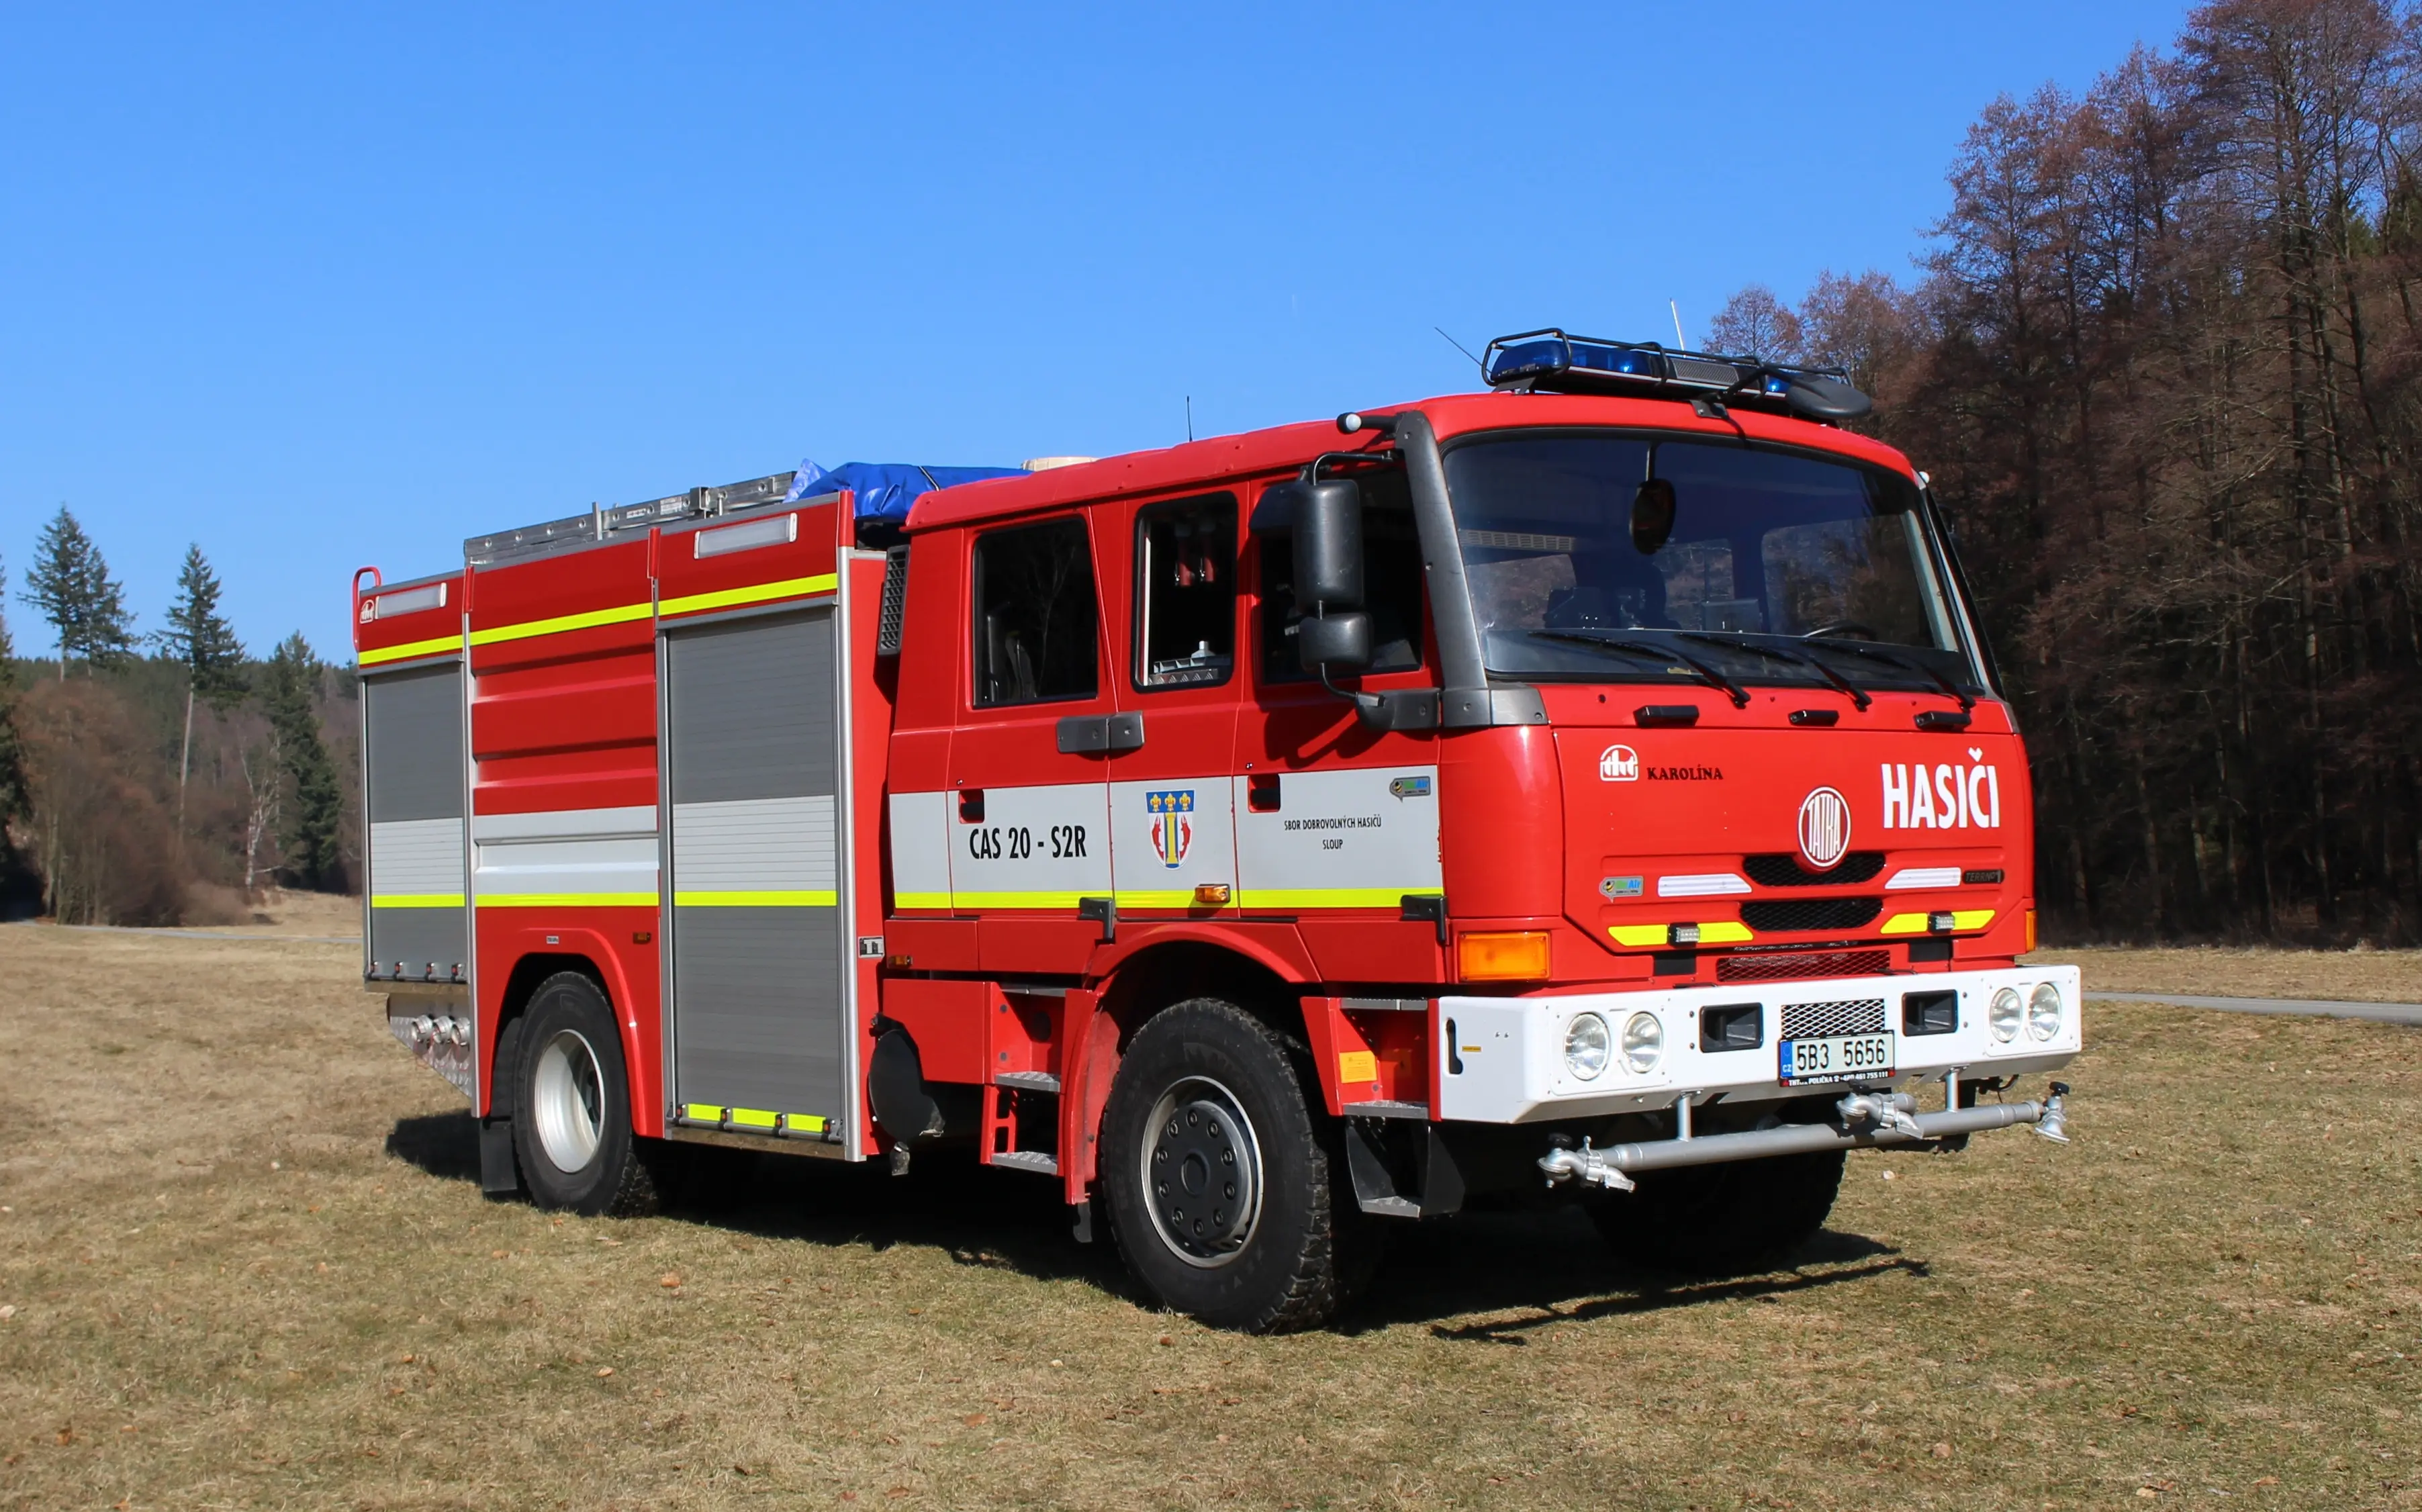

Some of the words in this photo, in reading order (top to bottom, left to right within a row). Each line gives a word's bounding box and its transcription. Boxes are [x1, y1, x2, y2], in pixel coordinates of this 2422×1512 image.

[1646, 764, 1723, 780] KAROLÍNA
[1881, 747, 2000, 829] HASIČI
[1284, 819, 1301, 831] SBOR
[1303, 815, 1356, 830] DOBROVOLNÝCH
[1357, 814, 1382, 828] HASIČŮ
[1807, 793, 1841, 860] TATRA
[970, 827, 1001, 859] CAS
[1008, 827, 1031, 859] 20
[1051, 825, 1087, 858] S2R
[1322, 839, 1343, 850] SLOUP
[1797, 1043, 1829, 1071] 5B3
[1844, 1039, 1885, 1067] 5656
[1782, 1064, 1792, 1072] CZ
[1808, 1075, 1832, 1085] POLIČKA
